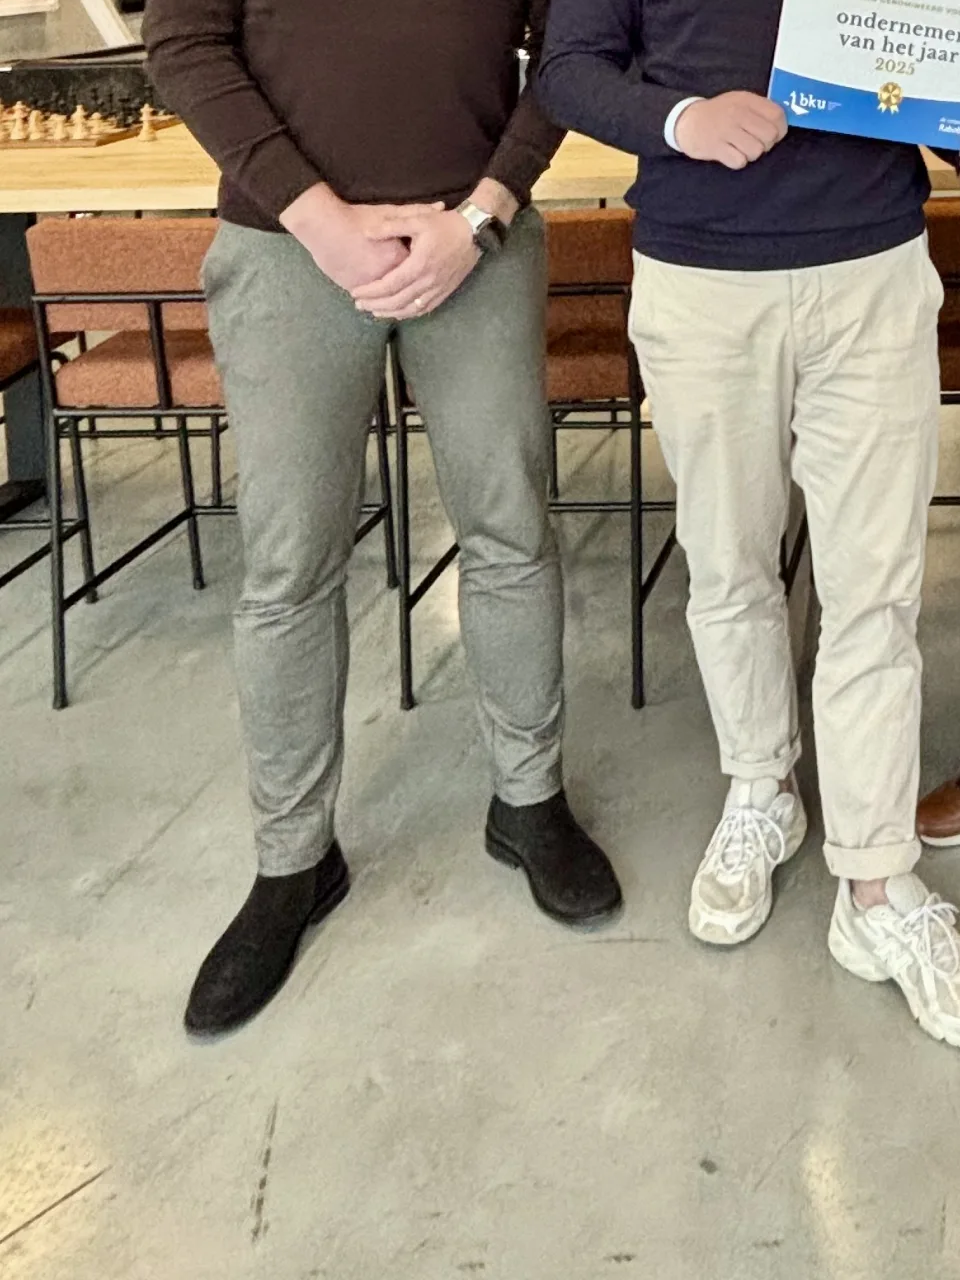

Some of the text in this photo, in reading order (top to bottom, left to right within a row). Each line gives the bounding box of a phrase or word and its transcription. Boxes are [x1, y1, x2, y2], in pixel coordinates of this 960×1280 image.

[839, 33, 960, 63] van het jaar
[875, 57, 916, 75] 2025
[799, 92, 826, 110] bku
